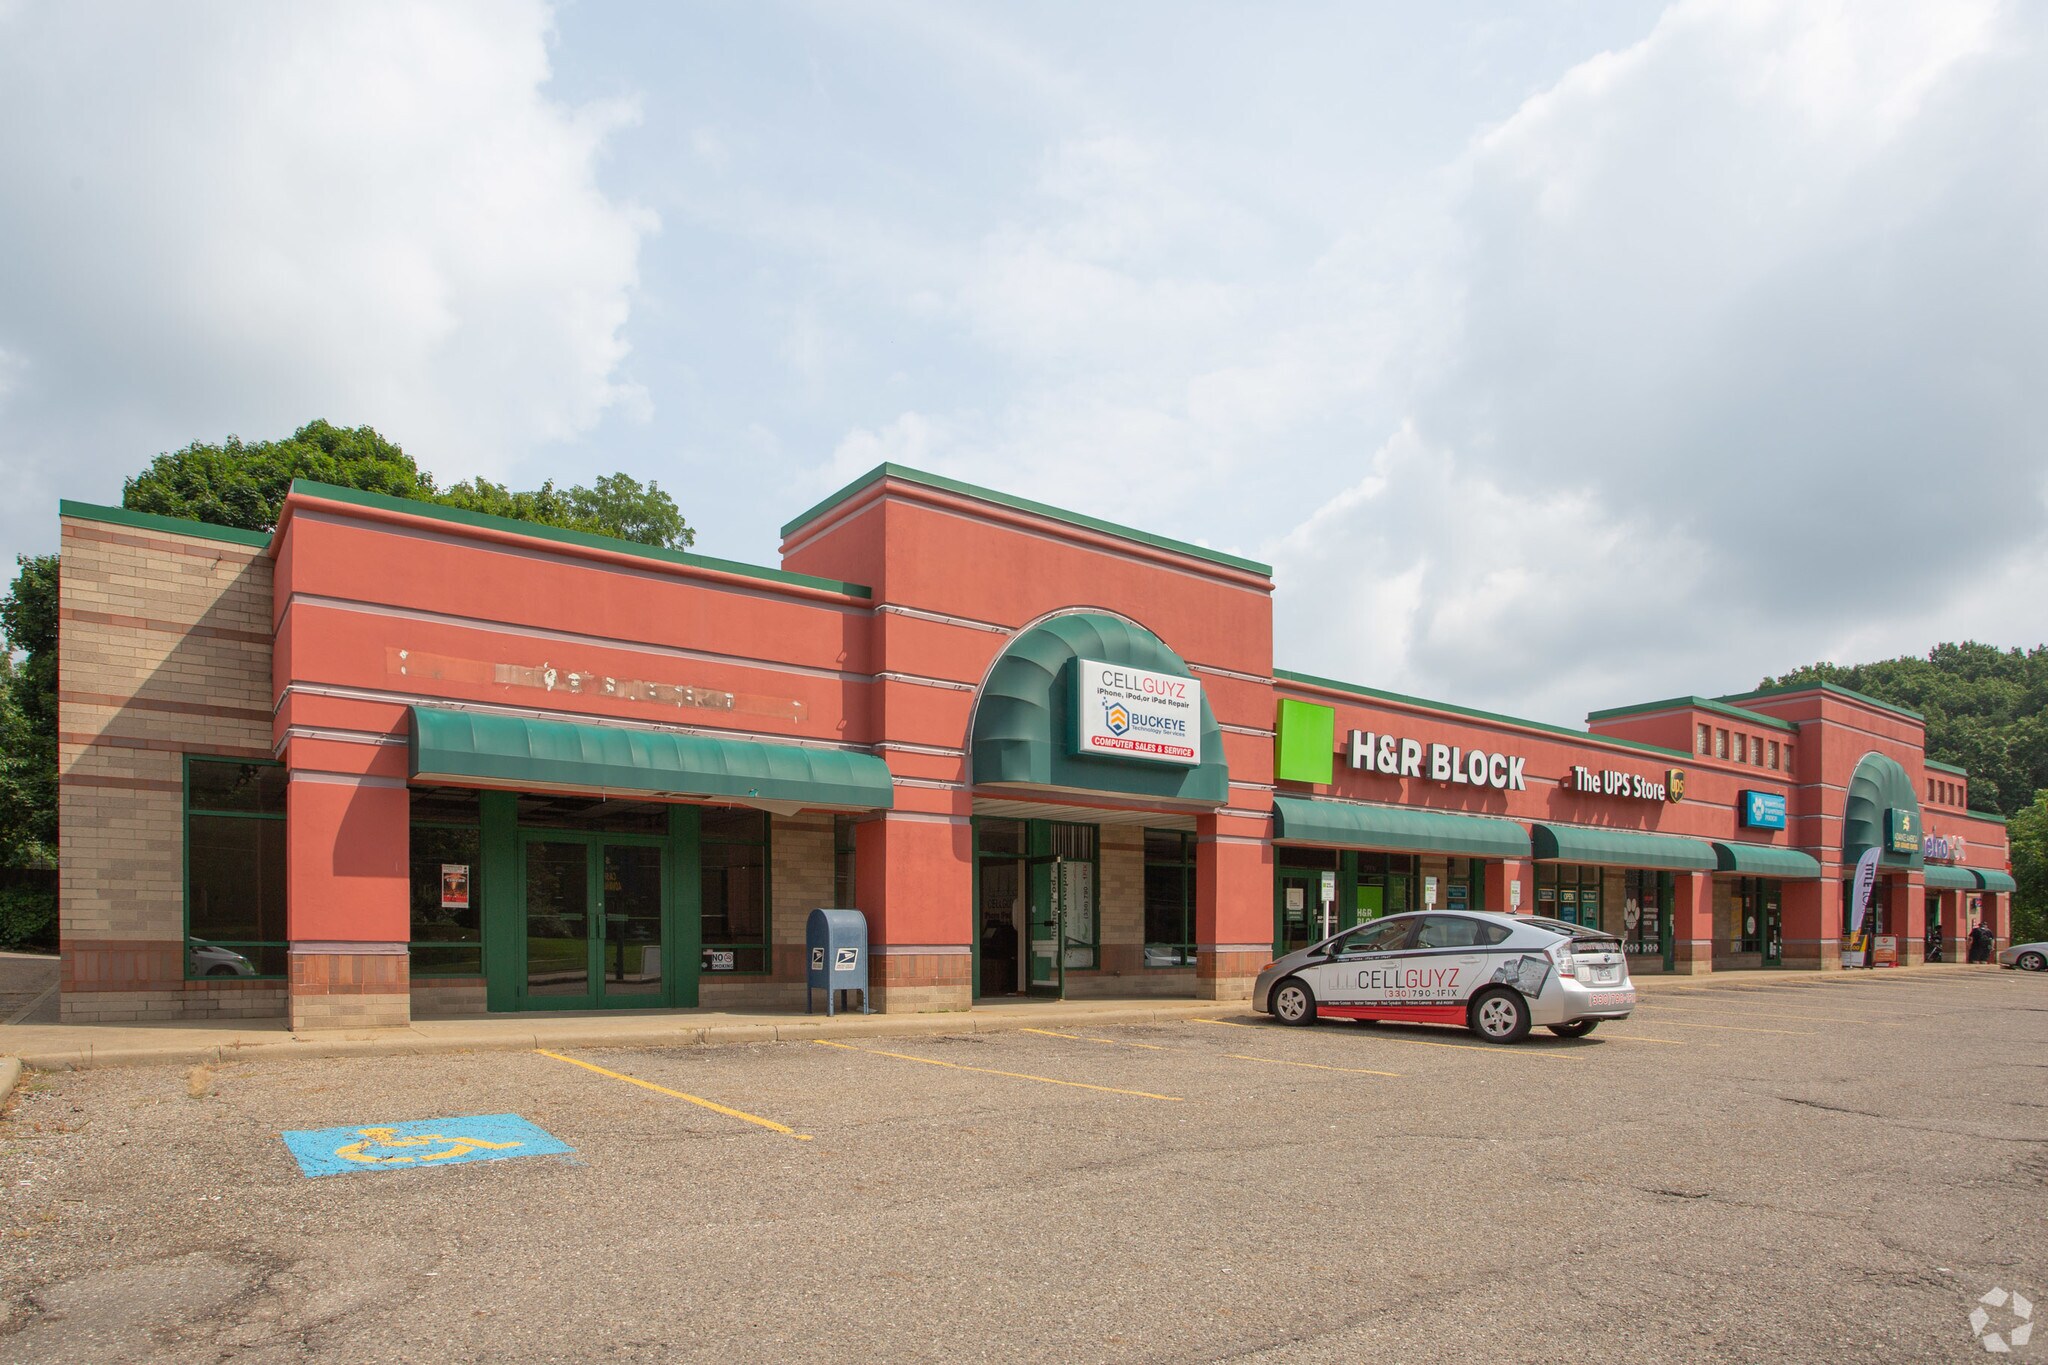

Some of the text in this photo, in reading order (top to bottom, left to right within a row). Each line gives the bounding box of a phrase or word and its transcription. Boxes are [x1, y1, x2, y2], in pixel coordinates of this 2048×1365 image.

[1101, 670, 1186, 699] CELLGUYZ
[1096, 687, 1124, 699] iPhone,
[1151, 696, 1167, 705] iPad
[1168, 699, 1189, 709] Repair
[1131, 713, 1186, 732] BUCKEYE
[1132, 725, 1186, 737] Technology Services
[1094, 737, 1192, 756] COMPUTER SALES & SERVICE
[1350, 729, 1527, 791] H&R BLOCK
[1574, 766, 1666, 801] The UPS Store
[1671, 779, 1684, 797] ups
[1863, 862, 1874, 887] TITLE
[1356, 908, 1373, 917] H&R
[712, 953, 723, 962] NO
[1358, 968, 1460, 989] CELLGUYZ
[1384, 989, 1457, 998] (330)790-1FIX
